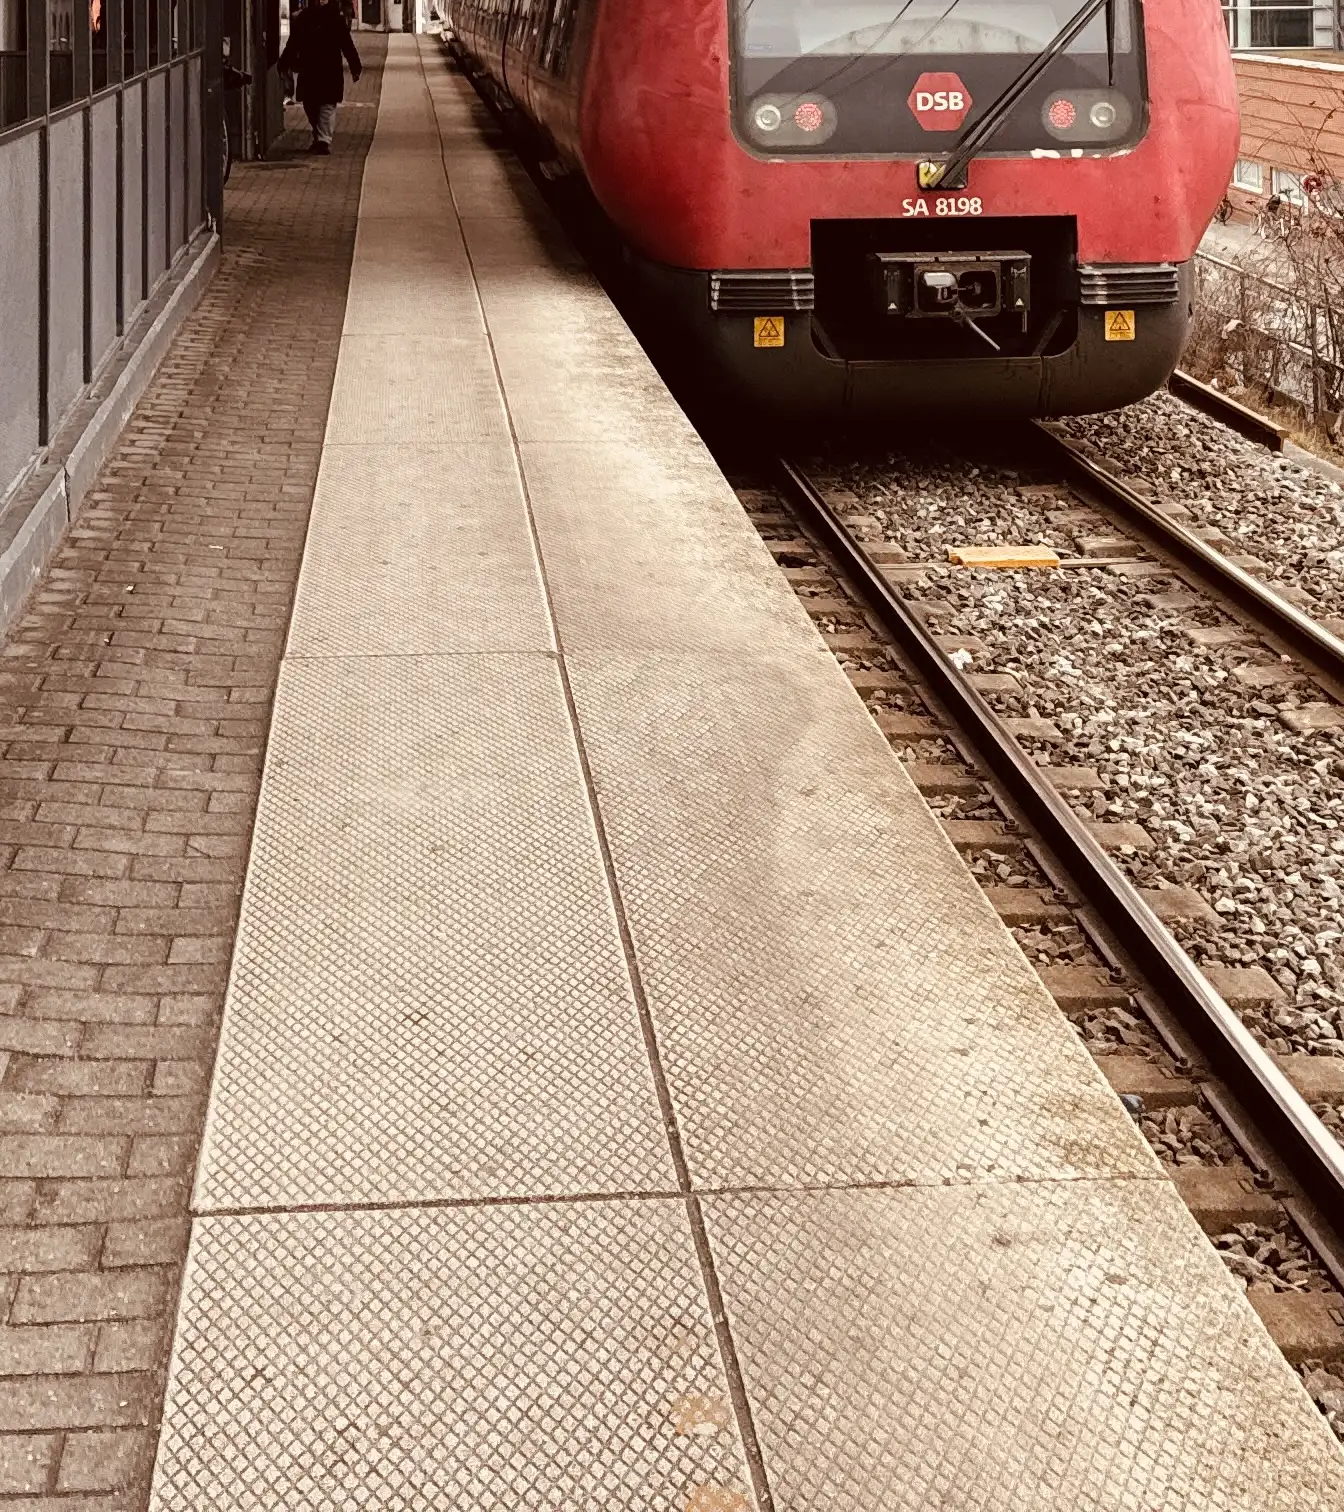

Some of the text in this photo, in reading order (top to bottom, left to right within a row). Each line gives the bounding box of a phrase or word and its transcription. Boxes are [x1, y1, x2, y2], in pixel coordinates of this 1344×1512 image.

[916, 91, 964, 111] DSB
[901, 197, 983, 217] SA 8198
